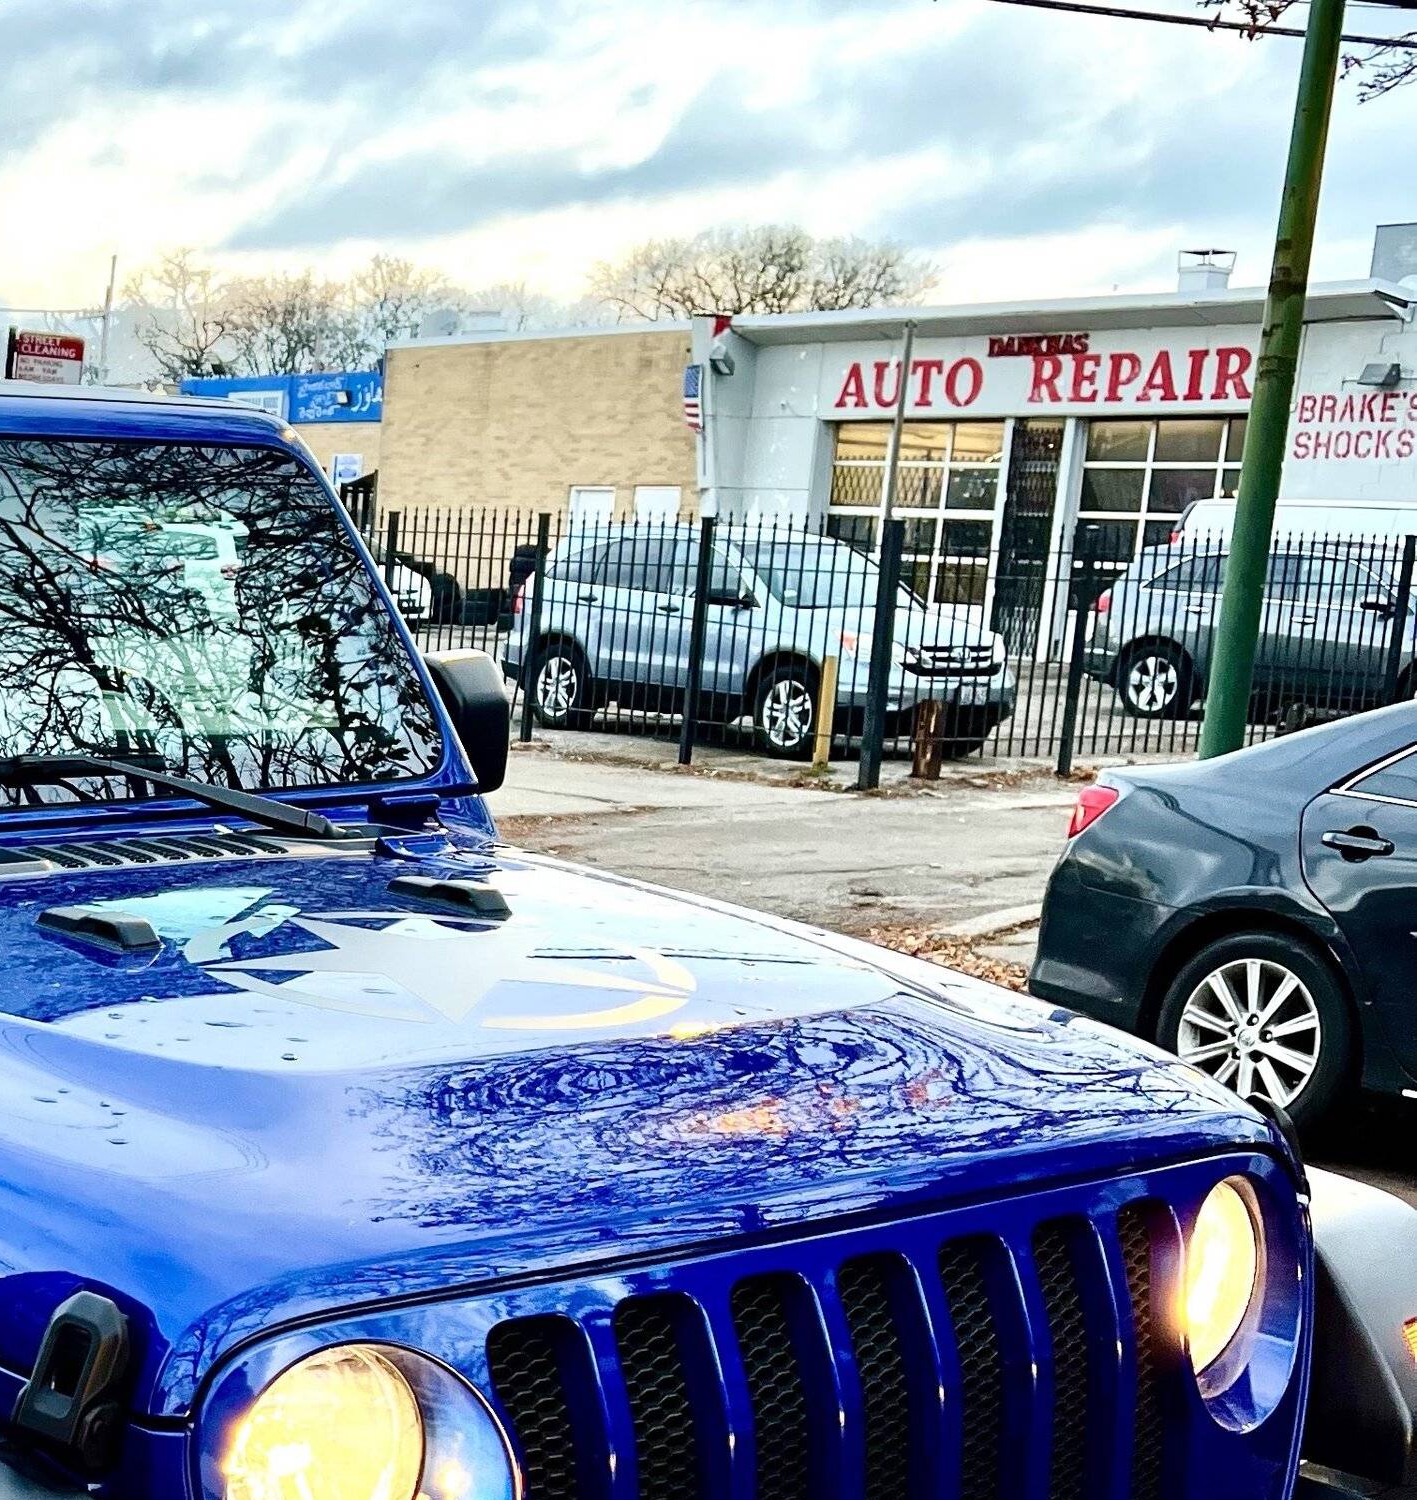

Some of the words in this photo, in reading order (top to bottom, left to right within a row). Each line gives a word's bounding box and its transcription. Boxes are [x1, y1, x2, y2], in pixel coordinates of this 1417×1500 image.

[21, 343, 77, 358] CLEANING
[23, 334, 62, 347] STREET
[834, 357, 984, 408] AUTO
[1027, 346, 1253, 403] REPAIR
[1293, 428, 1416, 460] SHOCKS
